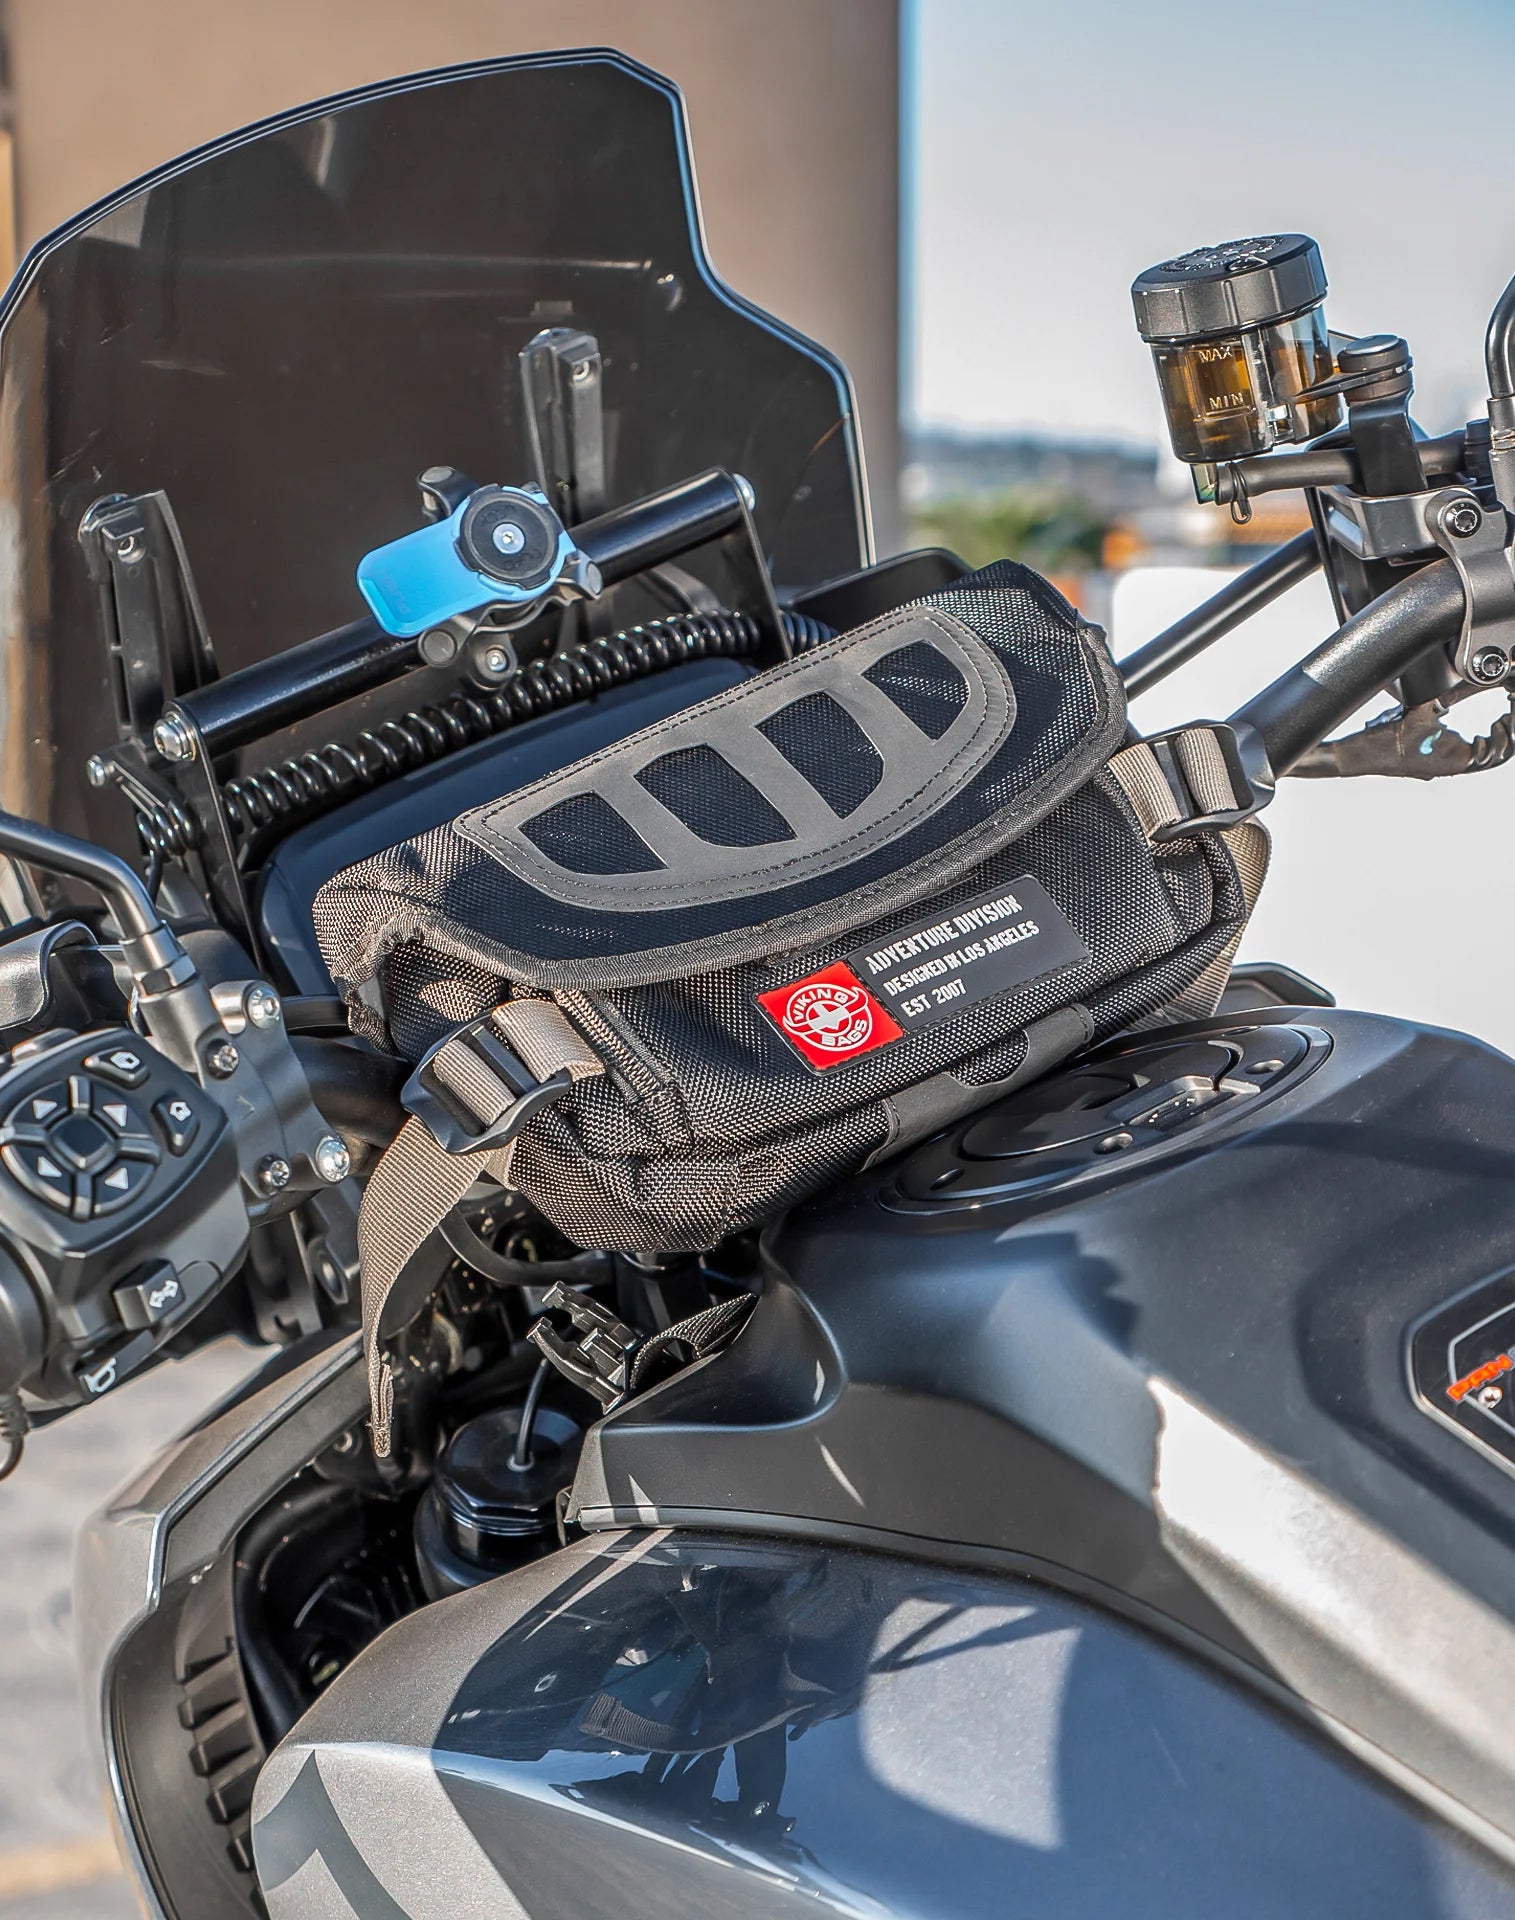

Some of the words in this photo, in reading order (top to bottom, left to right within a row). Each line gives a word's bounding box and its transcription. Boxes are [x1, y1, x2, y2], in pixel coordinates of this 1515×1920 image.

[1199, 346, 1233, 363] MAX
[1209, 392, 1244, 410] MIN
[864, 920, 960, 975] ADVENTURE
[953, 894, 1024, 935] DIVISION
[882, 958, 948, 997] DESIGNED
[943, 951, 962, 971] IN
[957, 942, 986, 964] LOS
[982, 920, 1040, 954] ANGELES
[792, 988, 849, 1021] VIKING
[900, 993, 932, 1018] EST
[931, 978, 968, 1005] 2007
[821, 1019, 868, 1047] BAGS
